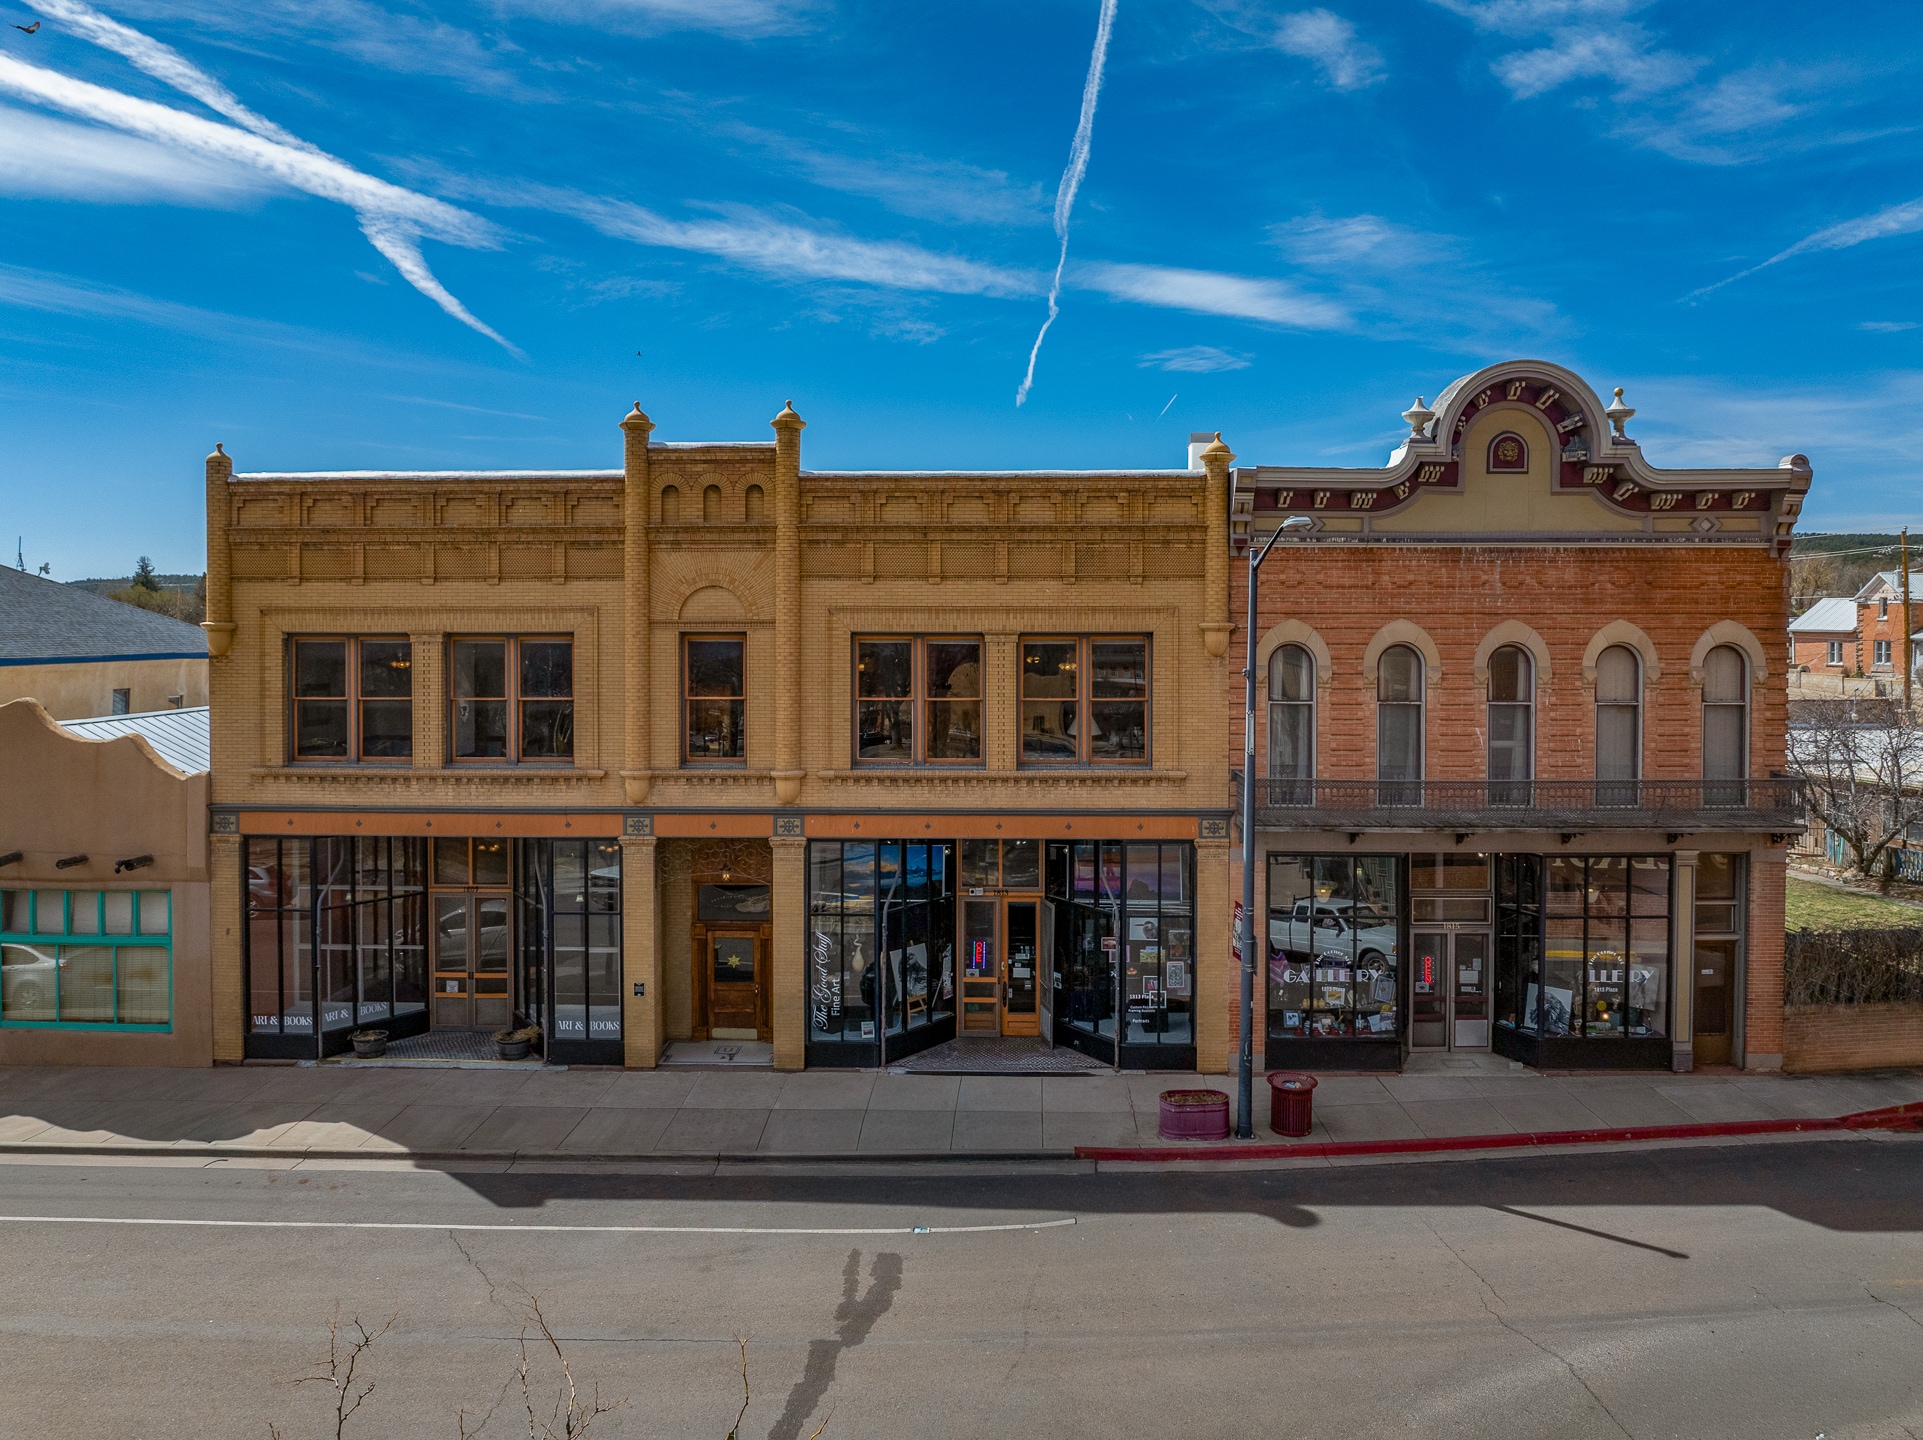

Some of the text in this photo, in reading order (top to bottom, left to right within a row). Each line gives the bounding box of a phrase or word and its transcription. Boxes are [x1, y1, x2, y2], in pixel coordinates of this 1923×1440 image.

[993, 888, 1009, 897] 1813
[1443, 922, 1460, 930] 1815
[812, 929, 833, 1030] The Good Stuff
[1283, 969, 1383, 983] GALLERY
[831, 978, 841, 1016] Fine Art
[324, 1002, 387, 1022] ART & BOOKS
[252, 1015, 313, 1026] ART & BOOKS
[558, 1020, 620, 1031] ART & BOOKS
